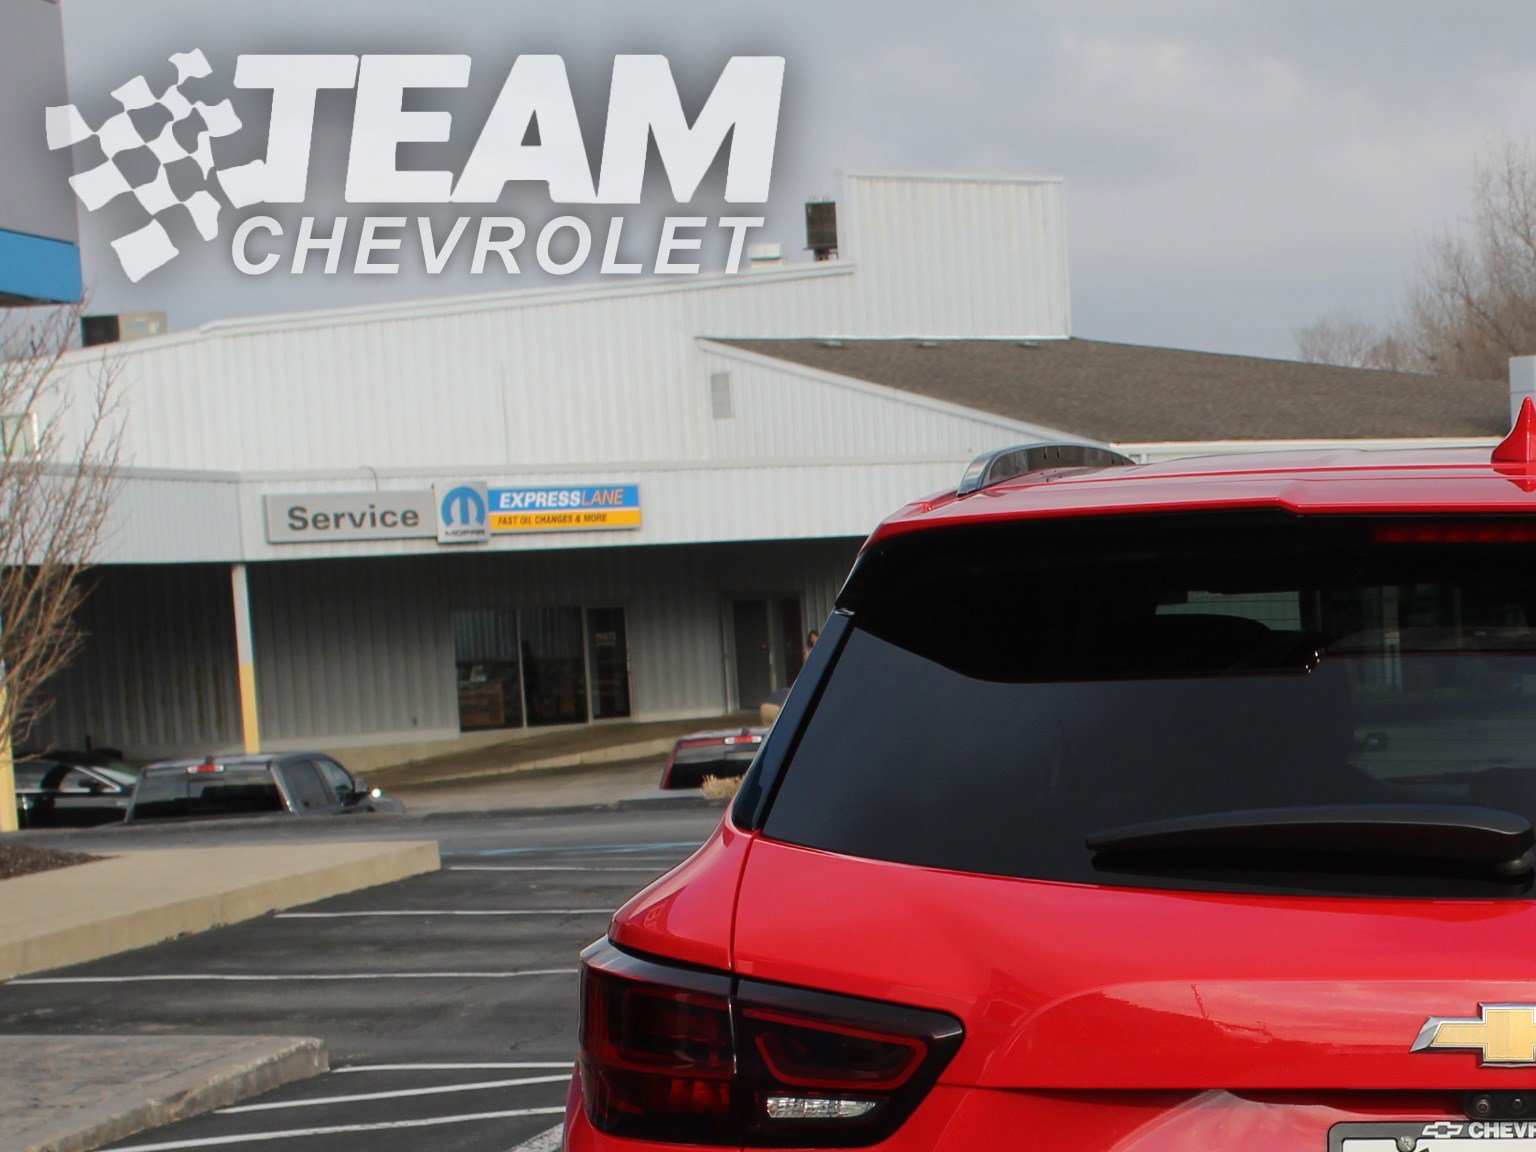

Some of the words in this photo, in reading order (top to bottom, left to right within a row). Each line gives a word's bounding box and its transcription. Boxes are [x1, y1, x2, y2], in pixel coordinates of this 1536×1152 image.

[287, 503, 420, 532] Service
[498, 516, 517, 526] FAST
[535, 514, 573, 525] CHANGES
[583, 512, 607, 523] MORE
